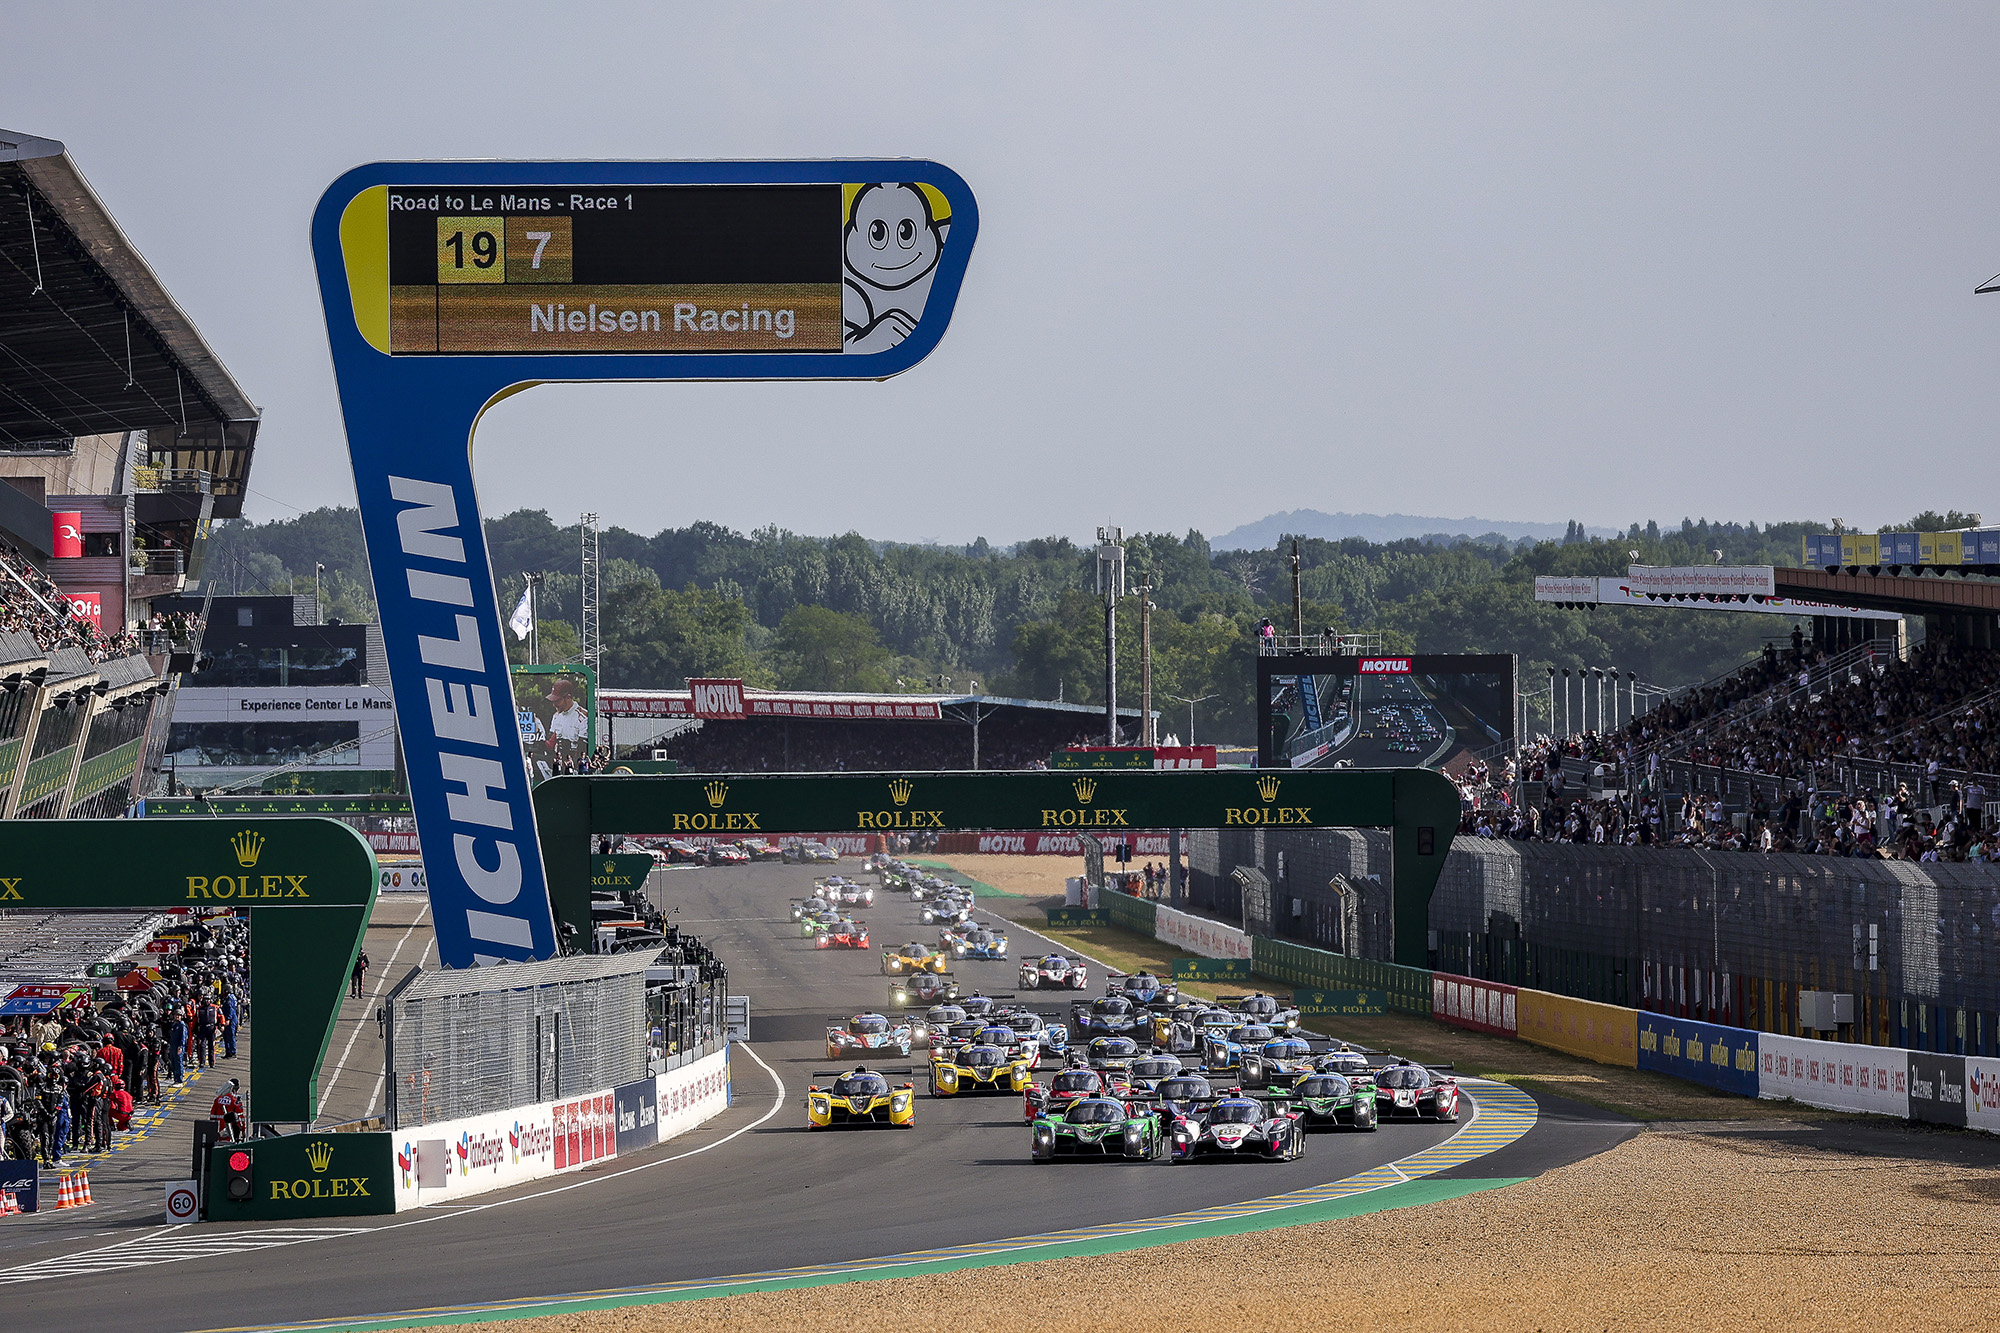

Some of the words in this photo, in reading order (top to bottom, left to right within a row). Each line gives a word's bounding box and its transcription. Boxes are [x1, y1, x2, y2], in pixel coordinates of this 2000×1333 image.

[390, 194, 439, 211] Road
[446, 195, 465, 211] to
[470, 194, 494, 211] Le
[501, 194, 552, 211] Mans
[570, 194, 618, 211] Race
[624, 194, 634, 210] 1
[445, 231, 498, 269] 19
[526, 231, 552, 269] 7
[530, 303, 661, 332] Nielsen
[673, 302, 796, 338] Racing
[1361, 660, 1409, 672] MOTUL
[241, 699, 301, 713] Experience
[305, 699, 342, 710] Center
[345, 698, 358, 709] Le
[362, 698, 392, 709] Mans
[694, 685, 743, 713] MOTUL
[522, 733, 546, 741] EDIA
[672, 812, 761, 830] ROLEX
[857, 811, 945, 828] ROLEX
[1041, 809, 1129, 826] ROLEX
[1225, 807, 1313, 824] ROLEX
[978, 835, 1026, 852] MOTUL
[186, 875, 310, 898] ROLEX
[591, 875, 632, 886] ROLEX
[167, 943, 178, 954] 13
[96, 964, 110, 975] 54
[1177, 972, 1209, 980] ROLEX
[1214, 972, 1247, 980] ROLEX
[36, 1001, 52, 1009] 15
[1299, 1005, 1338, 1014] ROLEX
[1342, 1005, 1382, 1014] ROLEX
[2, 1179, 34, 1187] WEC
[269, 1178, 371, 1199] ROLEX
[172, 1197, 192, 1209] 60
